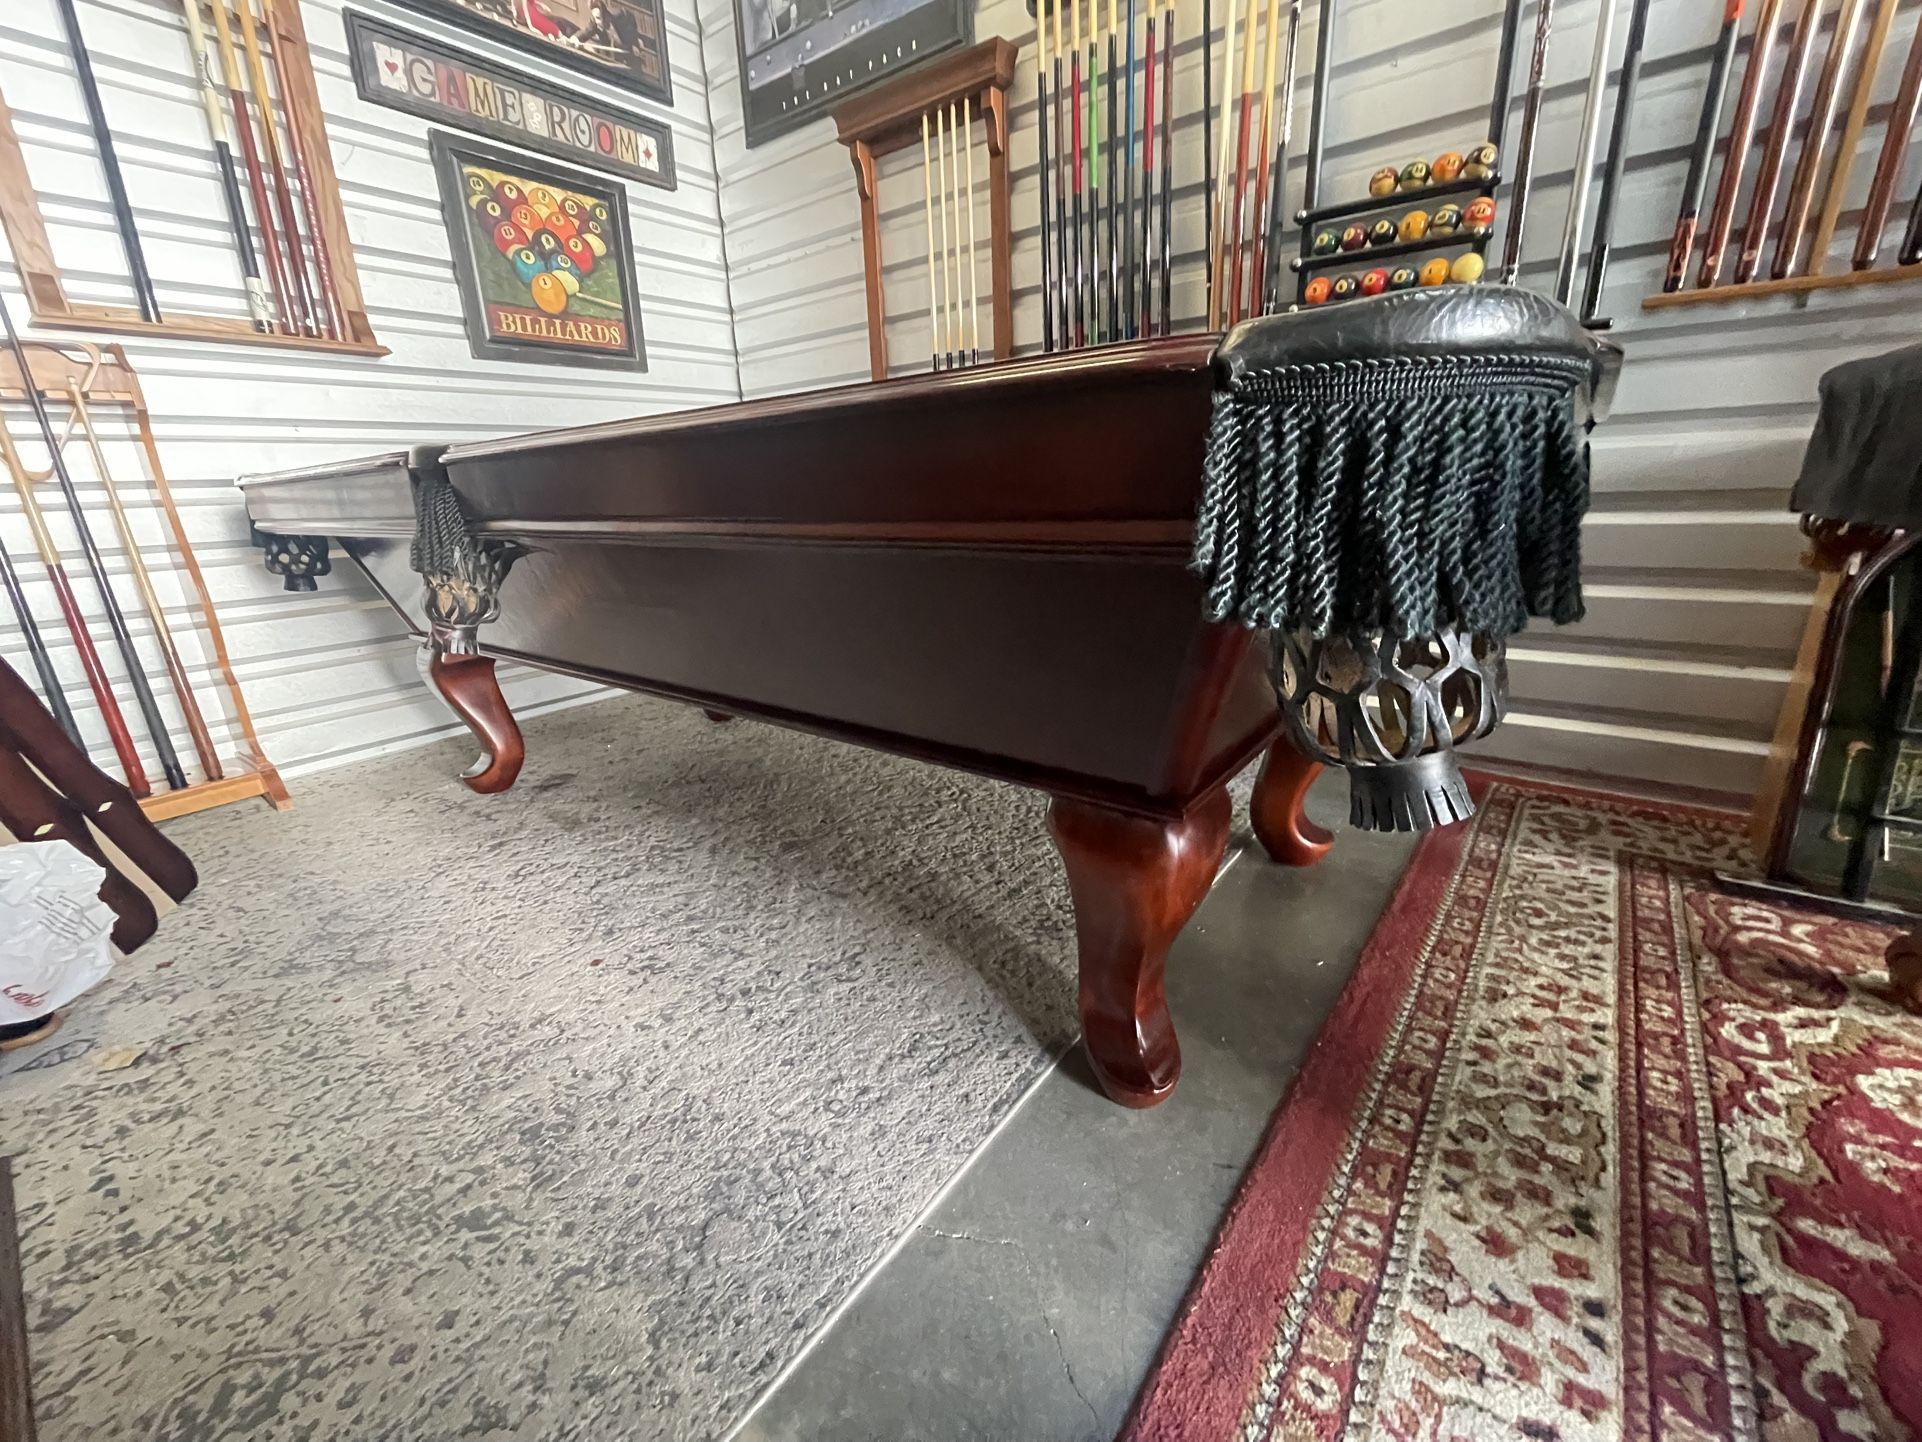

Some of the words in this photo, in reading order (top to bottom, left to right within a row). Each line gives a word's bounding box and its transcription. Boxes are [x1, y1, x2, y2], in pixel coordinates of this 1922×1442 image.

[409, 57, 521, 125] GAME
[547, 104, 636, 163] ROOM
[498, 312, 620, 345] BILLIARDS
